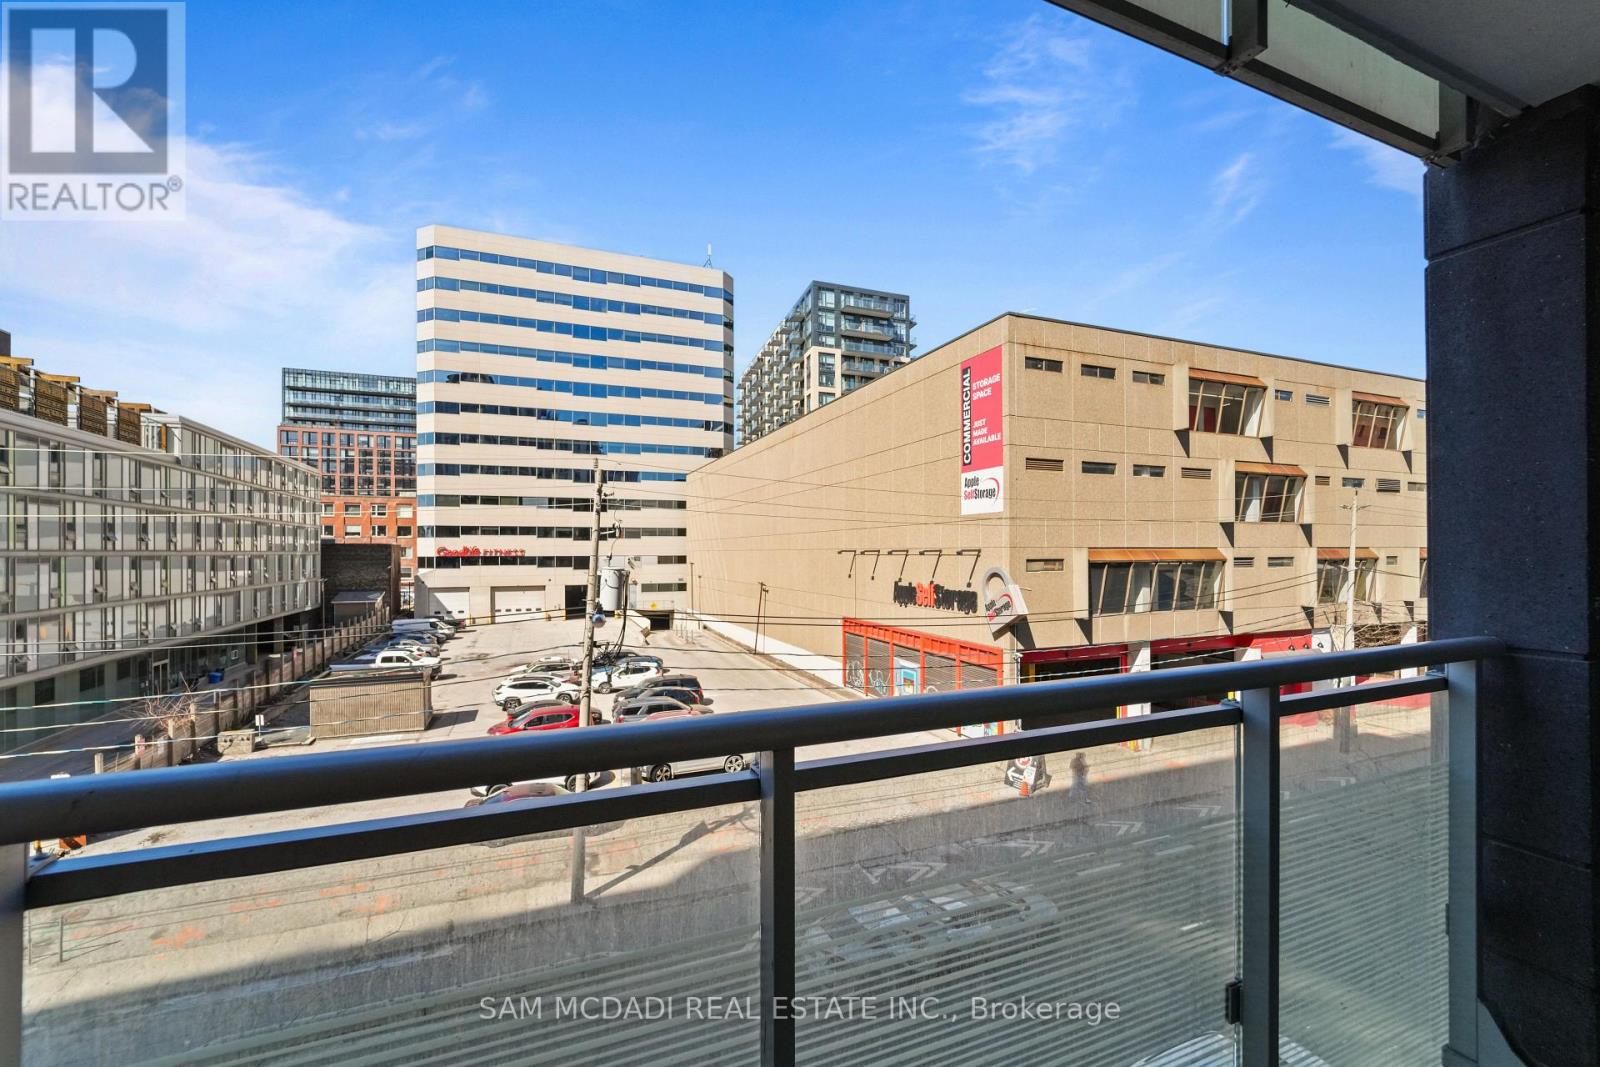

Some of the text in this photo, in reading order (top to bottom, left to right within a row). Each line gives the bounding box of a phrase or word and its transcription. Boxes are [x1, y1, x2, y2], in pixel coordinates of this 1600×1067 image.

[972, 373, 1001, 391] STORAGE
[972, 387, 992, 401] SPACE
[963, 368, 971, 464] COMMERCIAL
[973, 432, 1001, 446] AVAILABLE
